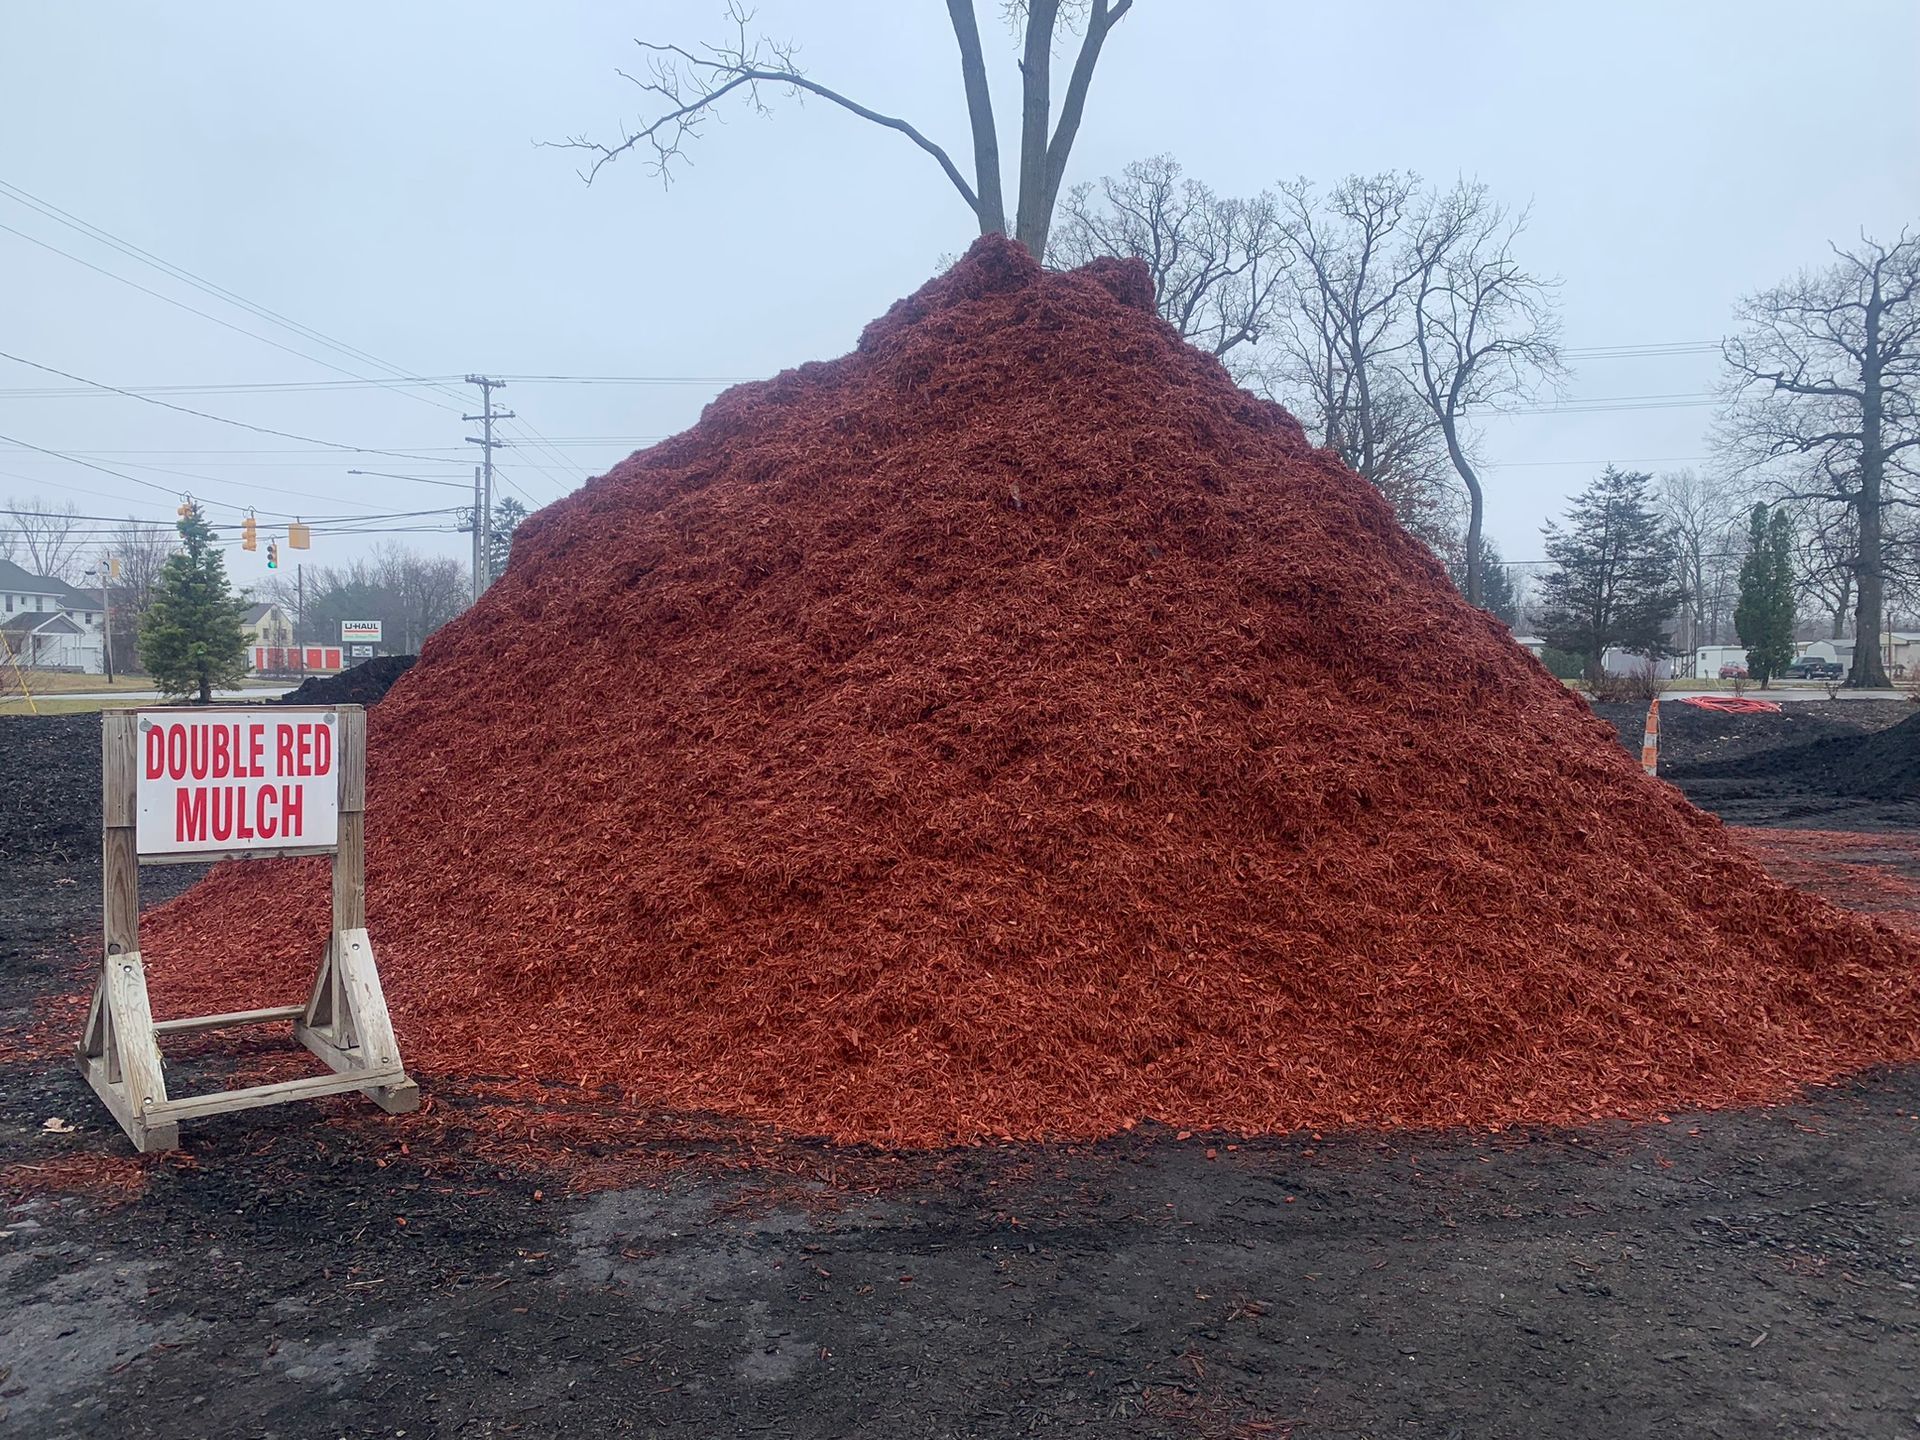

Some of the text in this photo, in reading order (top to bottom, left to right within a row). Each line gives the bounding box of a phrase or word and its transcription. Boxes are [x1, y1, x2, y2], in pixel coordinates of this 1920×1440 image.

[146, 723, 331, 780] DOUBLE RED
[176, 784, 303, 842] MULCH
